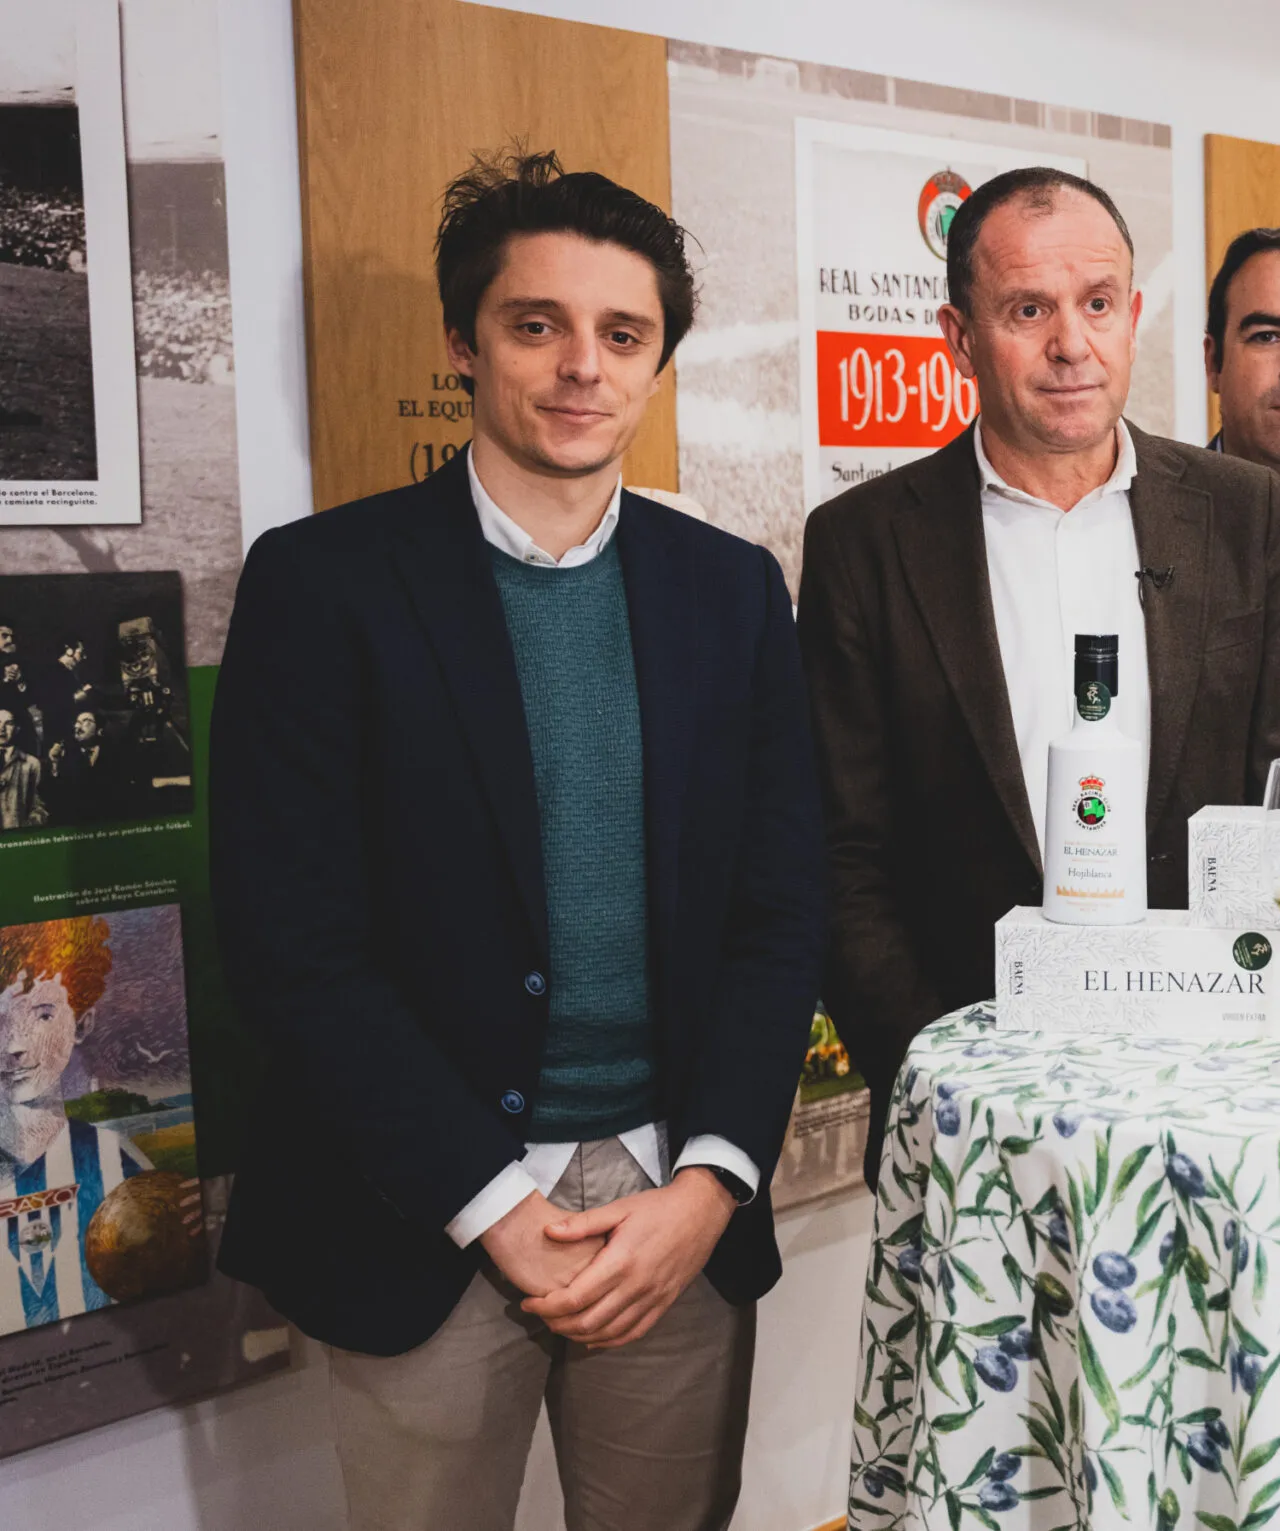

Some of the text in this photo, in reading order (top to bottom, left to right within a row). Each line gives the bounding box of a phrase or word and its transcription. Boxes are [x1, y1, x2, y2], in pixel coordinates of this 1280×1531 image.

[820, 268, 862, 296] REAL
[849, 304, 917, 325] BODAS
[398, 400, 424, 417] EL
[46, 498, 98, 506] racinguista.
[53, 831, 94, 844] televisiva
[96, 830, 108, 838] de
[121, 825, 152, 837] partido
[153, 823, 165, 832] de
[1064, 846, 1118, 857] EL HENAZAR
[1068, 867, 1113, 880] Hojiblanca
[1207, 857, 1217, 892] BAENA
[33, 891, 80, 903] Ilustración
[82, 889, 92, 897] de
[94, 886, 112, 896] José
[1014, 961, 1024, 996] BAENA
[1083, 970, 1267, 995] EL HENAZAR
[0, 1188, 73, 1217] RAYO
